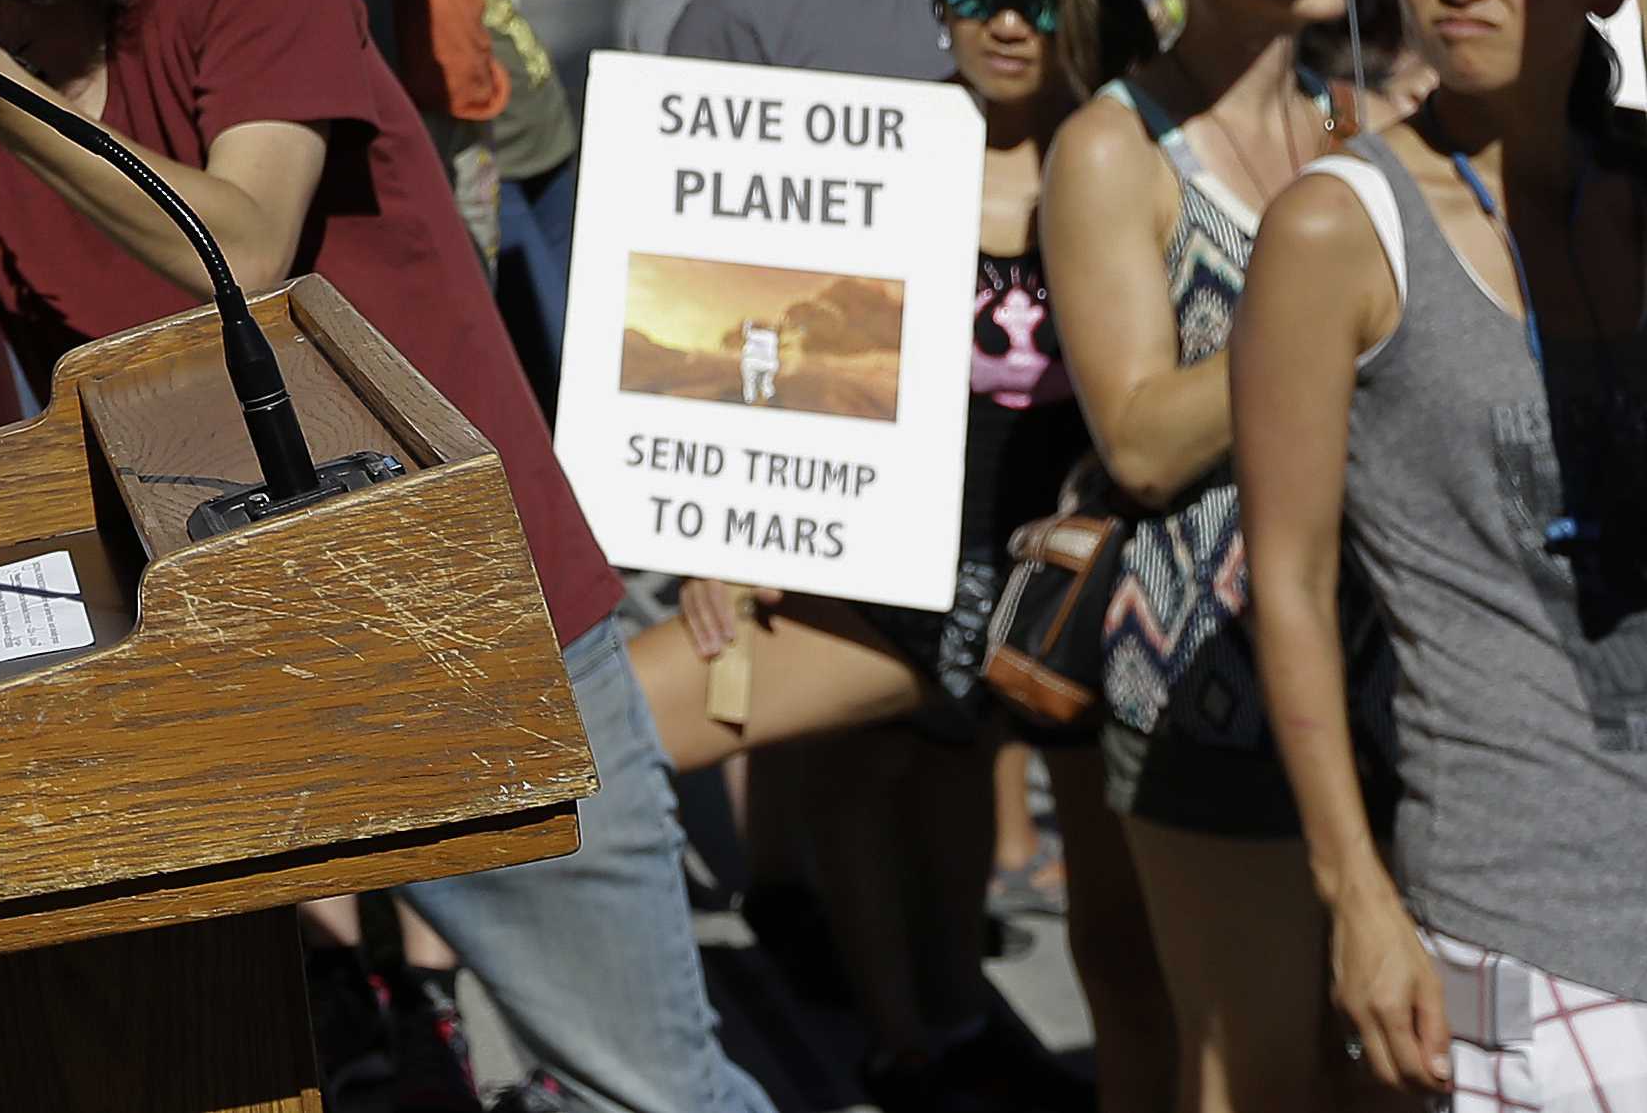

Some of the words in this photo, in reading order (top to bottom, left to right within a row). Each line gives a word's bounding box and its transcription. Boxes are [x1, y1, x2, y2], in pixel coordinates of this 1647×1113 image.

[659, 93, 784, 143] SAVE
[804, 103, 905, 150] OUR
[673, 168, 884, 228] PLANET
[625, 434, 725, 478] SEND
[743, 449, 878, 498] TRUMP
[649, 496, 704, 540] TO
[724, 506, 846, 559] MARS
